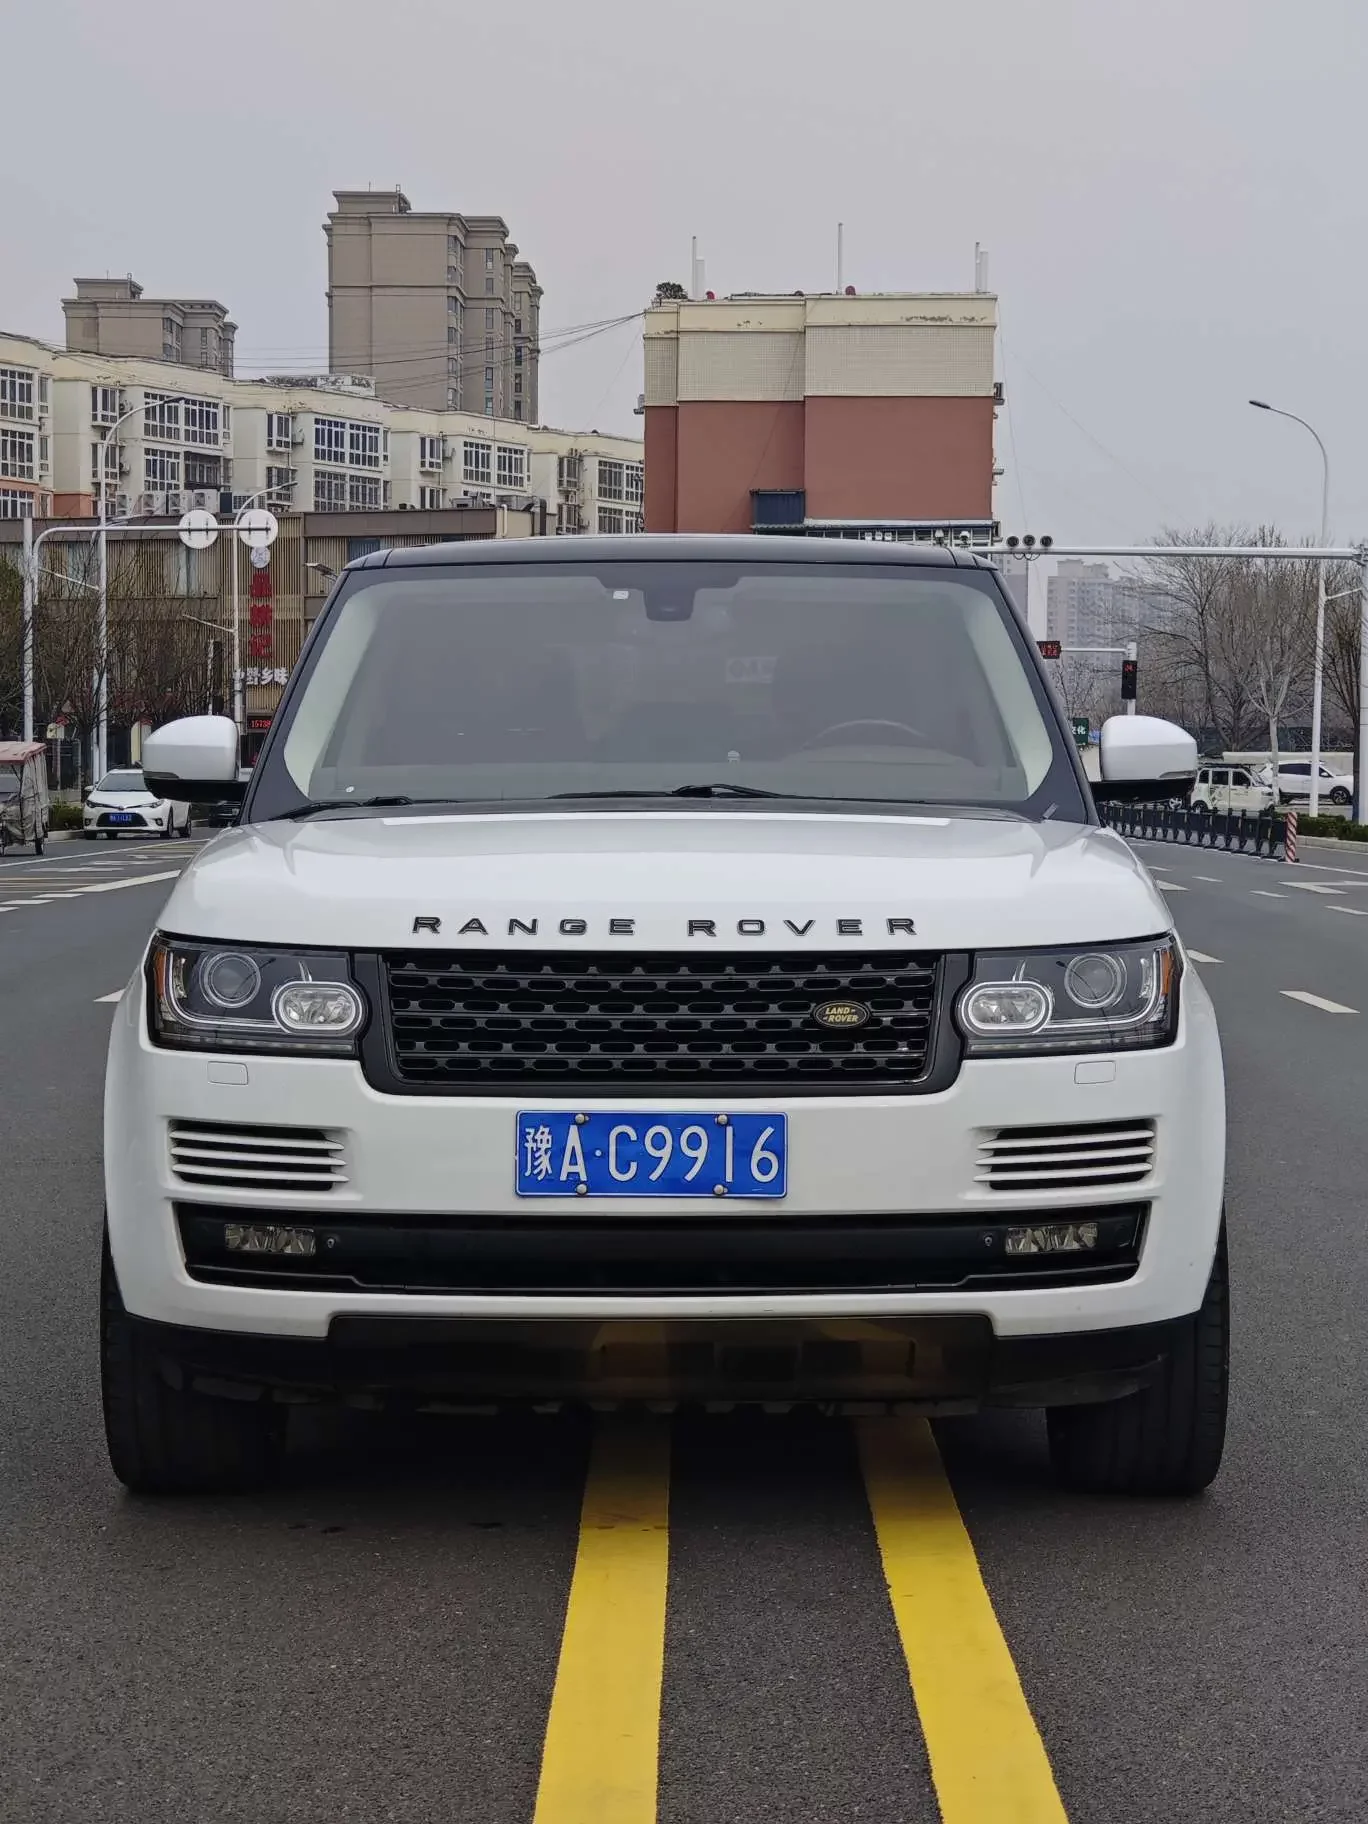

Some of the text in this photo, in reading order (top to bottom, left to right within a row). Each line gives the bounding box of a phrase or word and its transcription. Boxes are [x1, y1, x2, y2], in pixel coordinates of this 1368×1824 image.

[412, 916, 917, 937] RANGE ROVER
[828, 1014, 859, 1023] ROVER
[523, 1124, 780, 1183] 豫A·C9916
